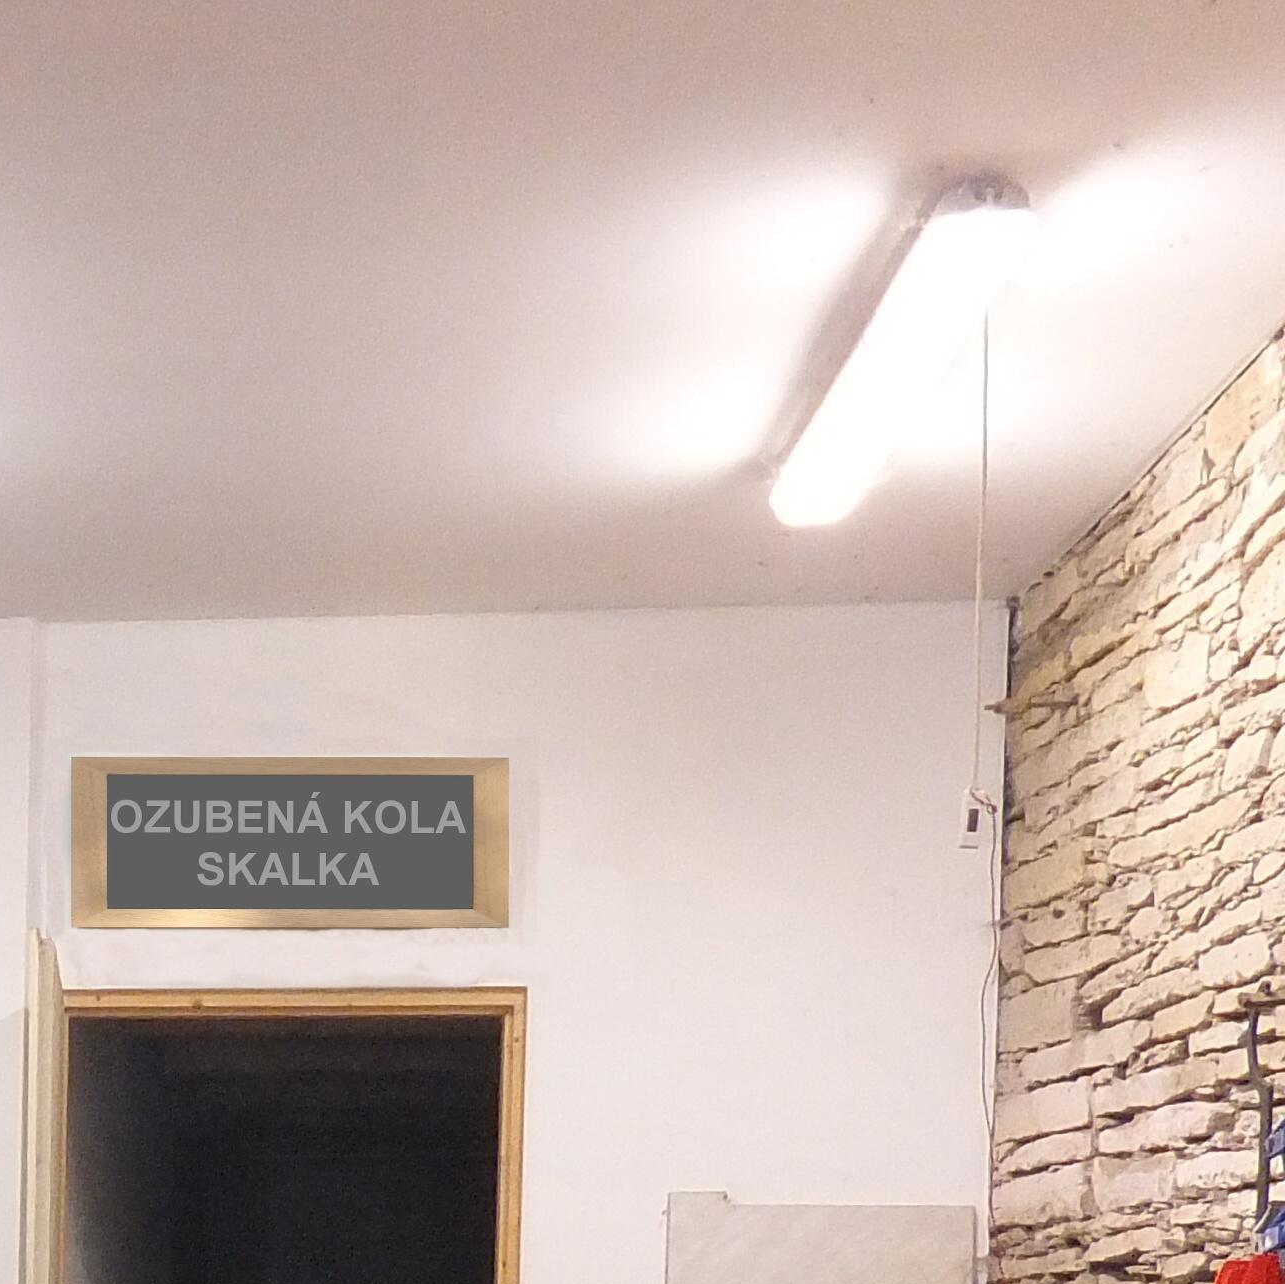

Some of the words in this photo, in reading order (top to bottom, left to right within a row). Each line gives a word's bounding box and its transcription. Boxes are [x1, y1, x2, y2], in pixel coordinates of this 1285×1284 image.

[111, 792, 329, 834] OZUBENÁ
[343, 799, 467, 835] KOLA
[197, 852, 380, 886] SKALKA
